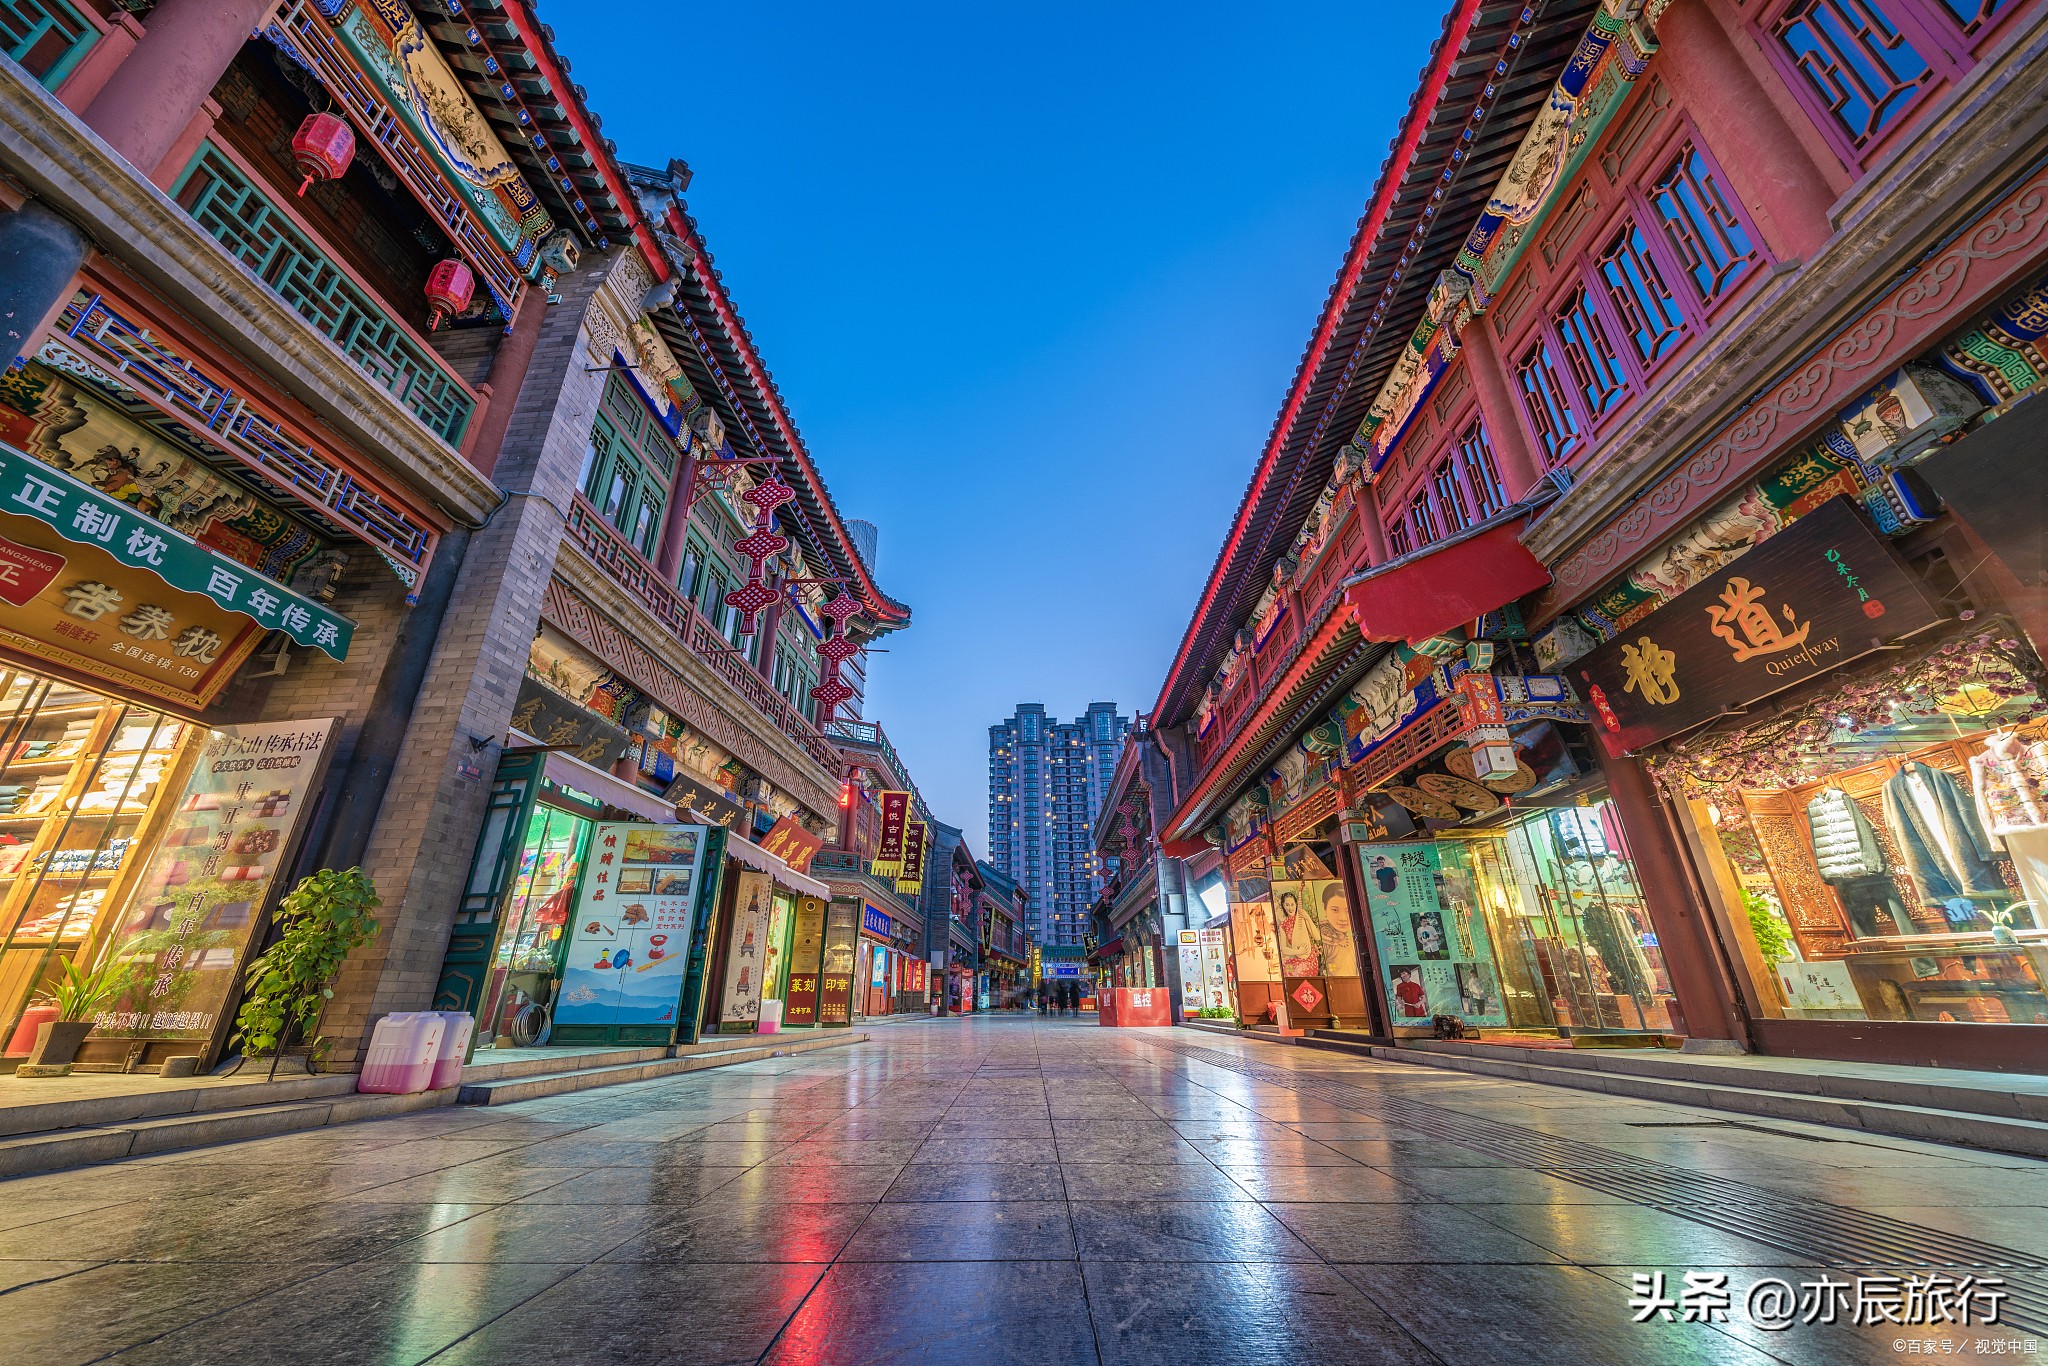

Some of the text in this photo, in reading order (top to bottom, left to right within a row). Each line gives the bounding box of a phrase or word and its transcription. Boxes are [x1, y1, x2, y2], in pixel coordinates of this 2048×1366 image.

[0, 461, 340, 648] 正制枕 百年传承
[53, 619, 100, 645] 瑞隆轩
[64, 580, 223, 665] 苦荞枕
[1765, 635, 1839, 677] Quiet way
[206, 731, 323, 757] 源于大山 传承古法
[592, 834, 617, 901] 馈赠佳品
[150, 781, 255, 998] 康正制枕 百年传承
[790, 978, 816, 993] 篆刻
[825, 977, 849, 993] 印章
[1300, 989, 1315, 1004] 福
[1133, 992, 1152, 1007] 监控
